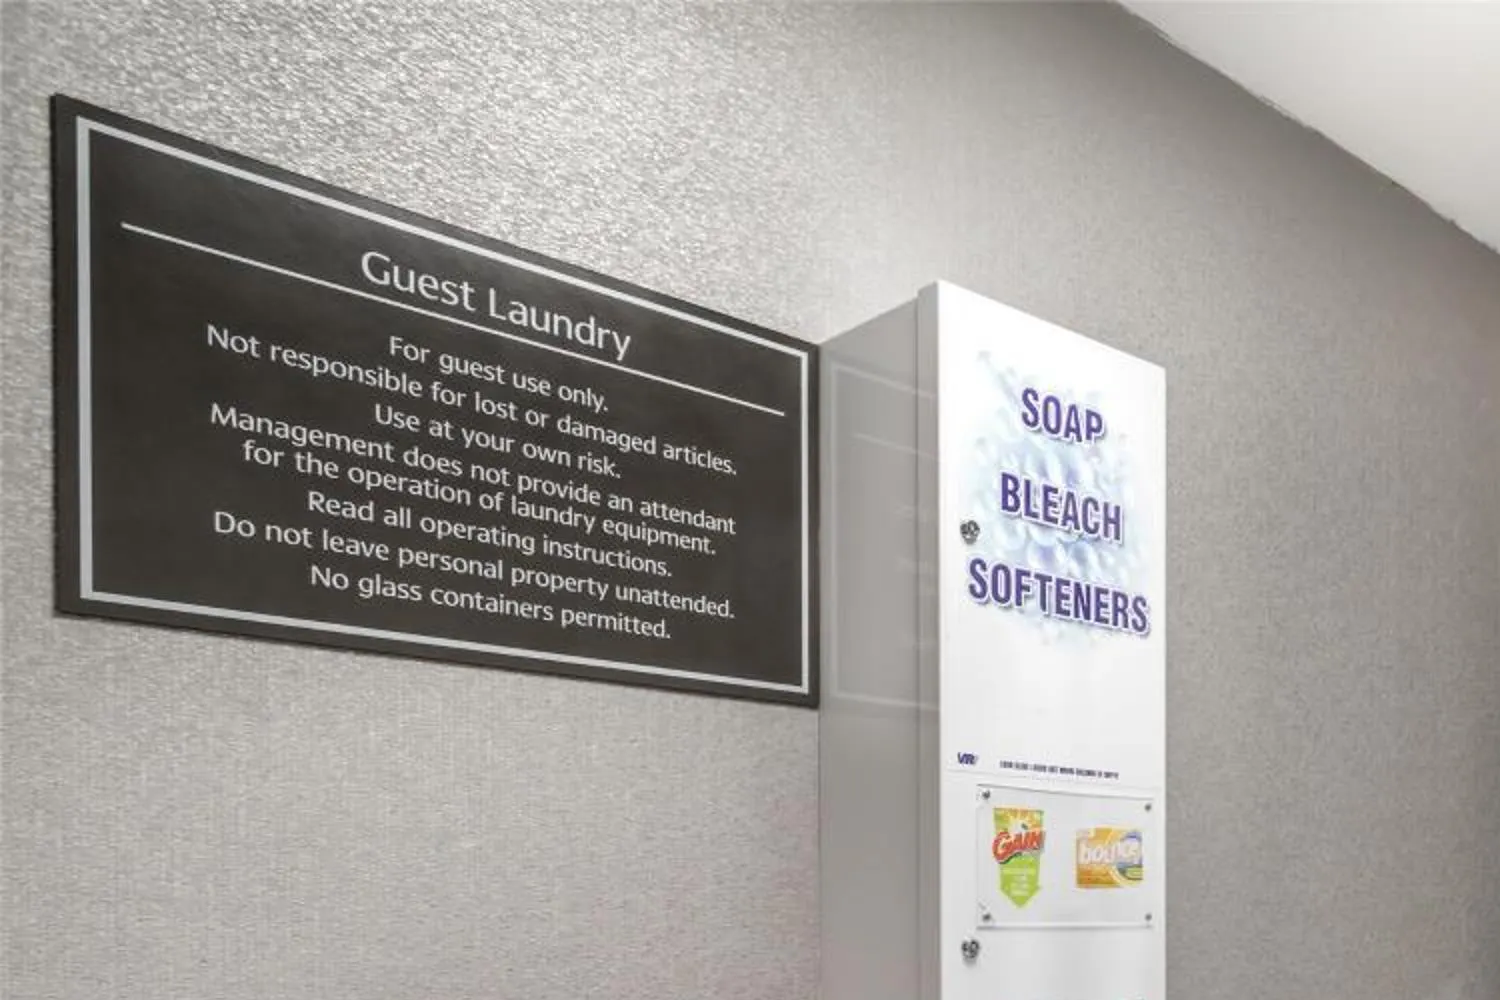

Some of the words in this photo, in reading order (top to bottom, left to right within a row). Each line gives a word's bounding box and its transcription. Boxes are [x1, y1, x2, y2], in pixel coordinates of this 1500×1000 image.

[360, 250, 476, 312] Guest
[488, 287, 632, 361] Laundry
[206, 323, 260, 358] Not
[270, 344, 423, 397] responsible
[430, 380, 467, 407] for
[474, 390, 518, 421] lost
[524, 408, 549, 428] or
[556, 414, 657, 455] damaged
[662, 442, 737, 475] articles.
[389, 334, 431, 364] For
[438, 352, 506, 385] guest
[511, 371, 551, 397] use
[557, 384, 609, 414] only.
[1021, 387, 1104, 442] SOAP
[210, 402, 395, 463] Management
[402, 445, 463, 477] does
[470, 463, 511, 487] not
[517, 474, 601, 506] provide
[606, 493, 633, 513] an
[638, 500, 737, 535] attendant
[374, 402, 420, 433] Use
[427, 419, 454, 441] at
[460, 426, 516, 453] your
[521, 442, 571, 467] own
[577, 450, 621, 479] risk.
[242, 438, 284, 467] for
[293, 450, 339, 479] the
[346, 466, 471, 506] operation
[478, 490, 504, 511] of
[510, 494, 596, 534] laundry
[601, 518, 716, 555] equipment.
[307, 490, 374, 522] Read
[382, 506, 411, 529] all
[419, 516, 535, 556] operating
[542, 533, 672, 577] instructions.
[1000, 472, 1123, 541] BLEACH
[214, 510, 256, 537] Do
[264, 523, 312, 549] not
[322, 527, 389, 561] leave
[397, 546, 503, 580] personal
[510, 566, 609, 601] property
[614, 584, 735, 619] unattended.
[310, 564, 349, 590] No
[357, 572, 422, 601] glass
[429, 587, 554, 621] containers
[560, 607, 671, 639] permitted.
[968, 557, 1149, 633] SOFTENERS
